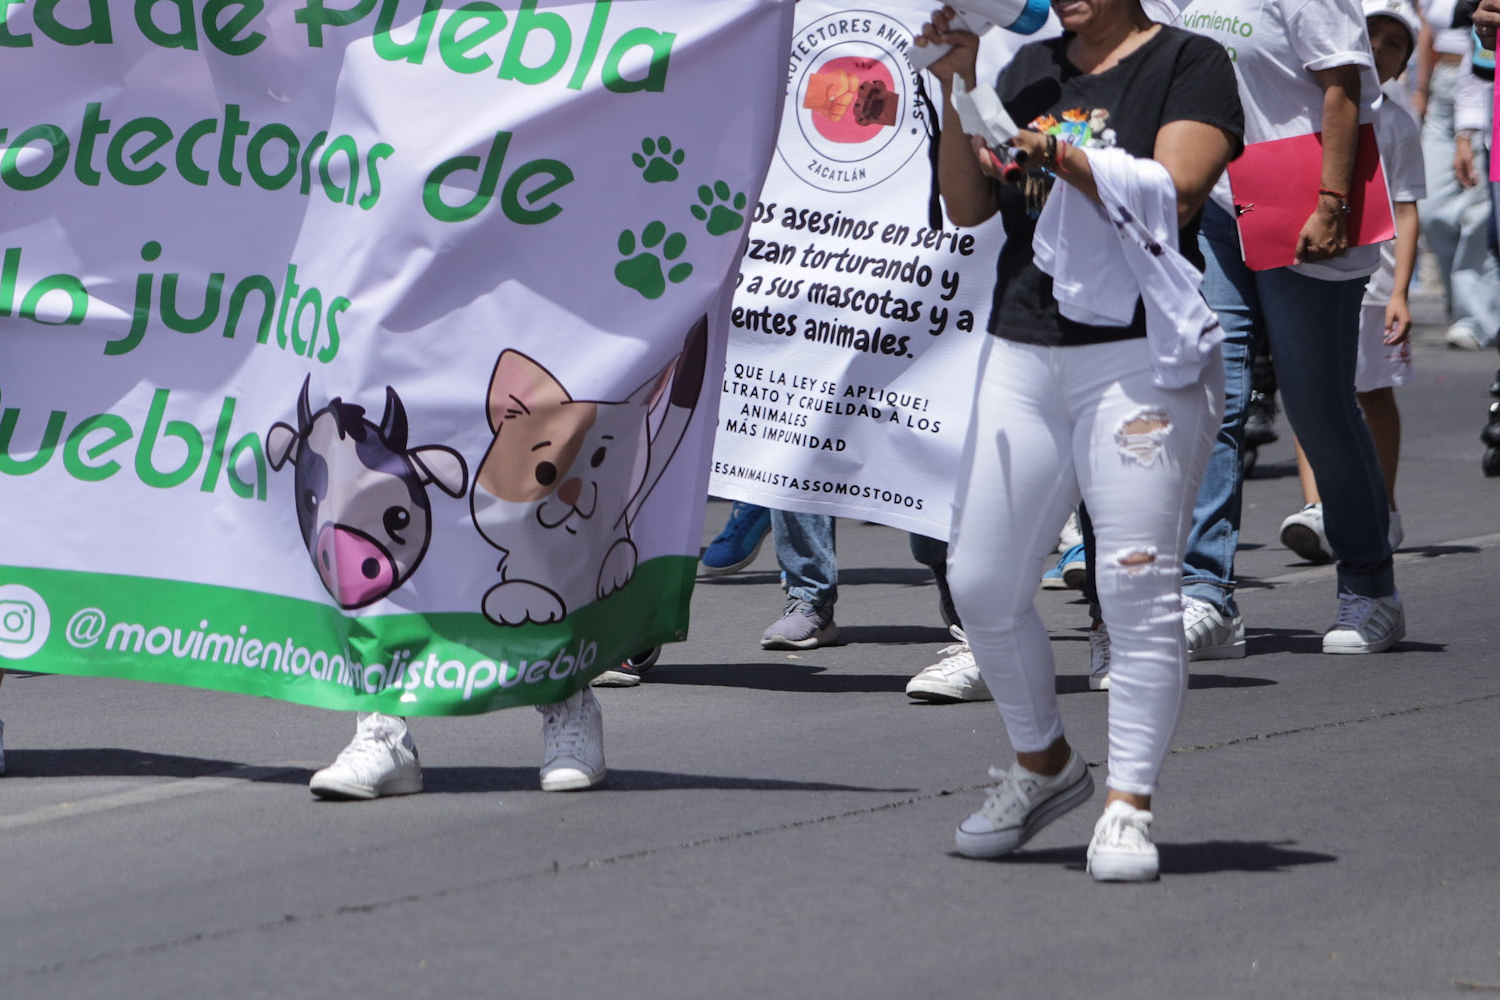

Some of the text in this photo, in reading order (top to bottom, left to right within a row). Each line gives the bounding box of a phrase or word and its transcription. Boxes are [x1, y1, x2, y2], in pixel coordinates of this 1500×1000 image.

[421, 129, 576, 226] de
[807, 159, 867, 182] ZACATLÁN
[781, 207, 879, 241] asesinos
[881, 223, 910, 247] en
[911, 226, 975, 256] serie
[800, 243, 933, 287] torturando
[940, 270, 960, 301] y
[102, 240, 352, 364] juntas
[746, 275, 763, 295] a
[765, 276, 805, 300] sus
[807, 280, 923, 323] mascotas
[928, 305, 949, 336] y
[956, 310, 974, 333] a
[803, 318, 914, 359] animales.
[734, 363, 764, 380] QUE
[769, 370, 787, 386] LA
[792, 378, 818, 391] LEY
[820, 381, 836, 396] SE
[843, 384, 930, 413] APLIQUE!
[726, 417, 757, 437] MÁS
[762, 426, 847, 452] IMPUNIDAD
[740, 403, 808, 428] ANIMALES
[786, 392, 796, 406] Y
[799, 396, 883, 420] CRUELDAD
[889, 411, 900, 424] A
[907, 418, 942, 435] LOS
